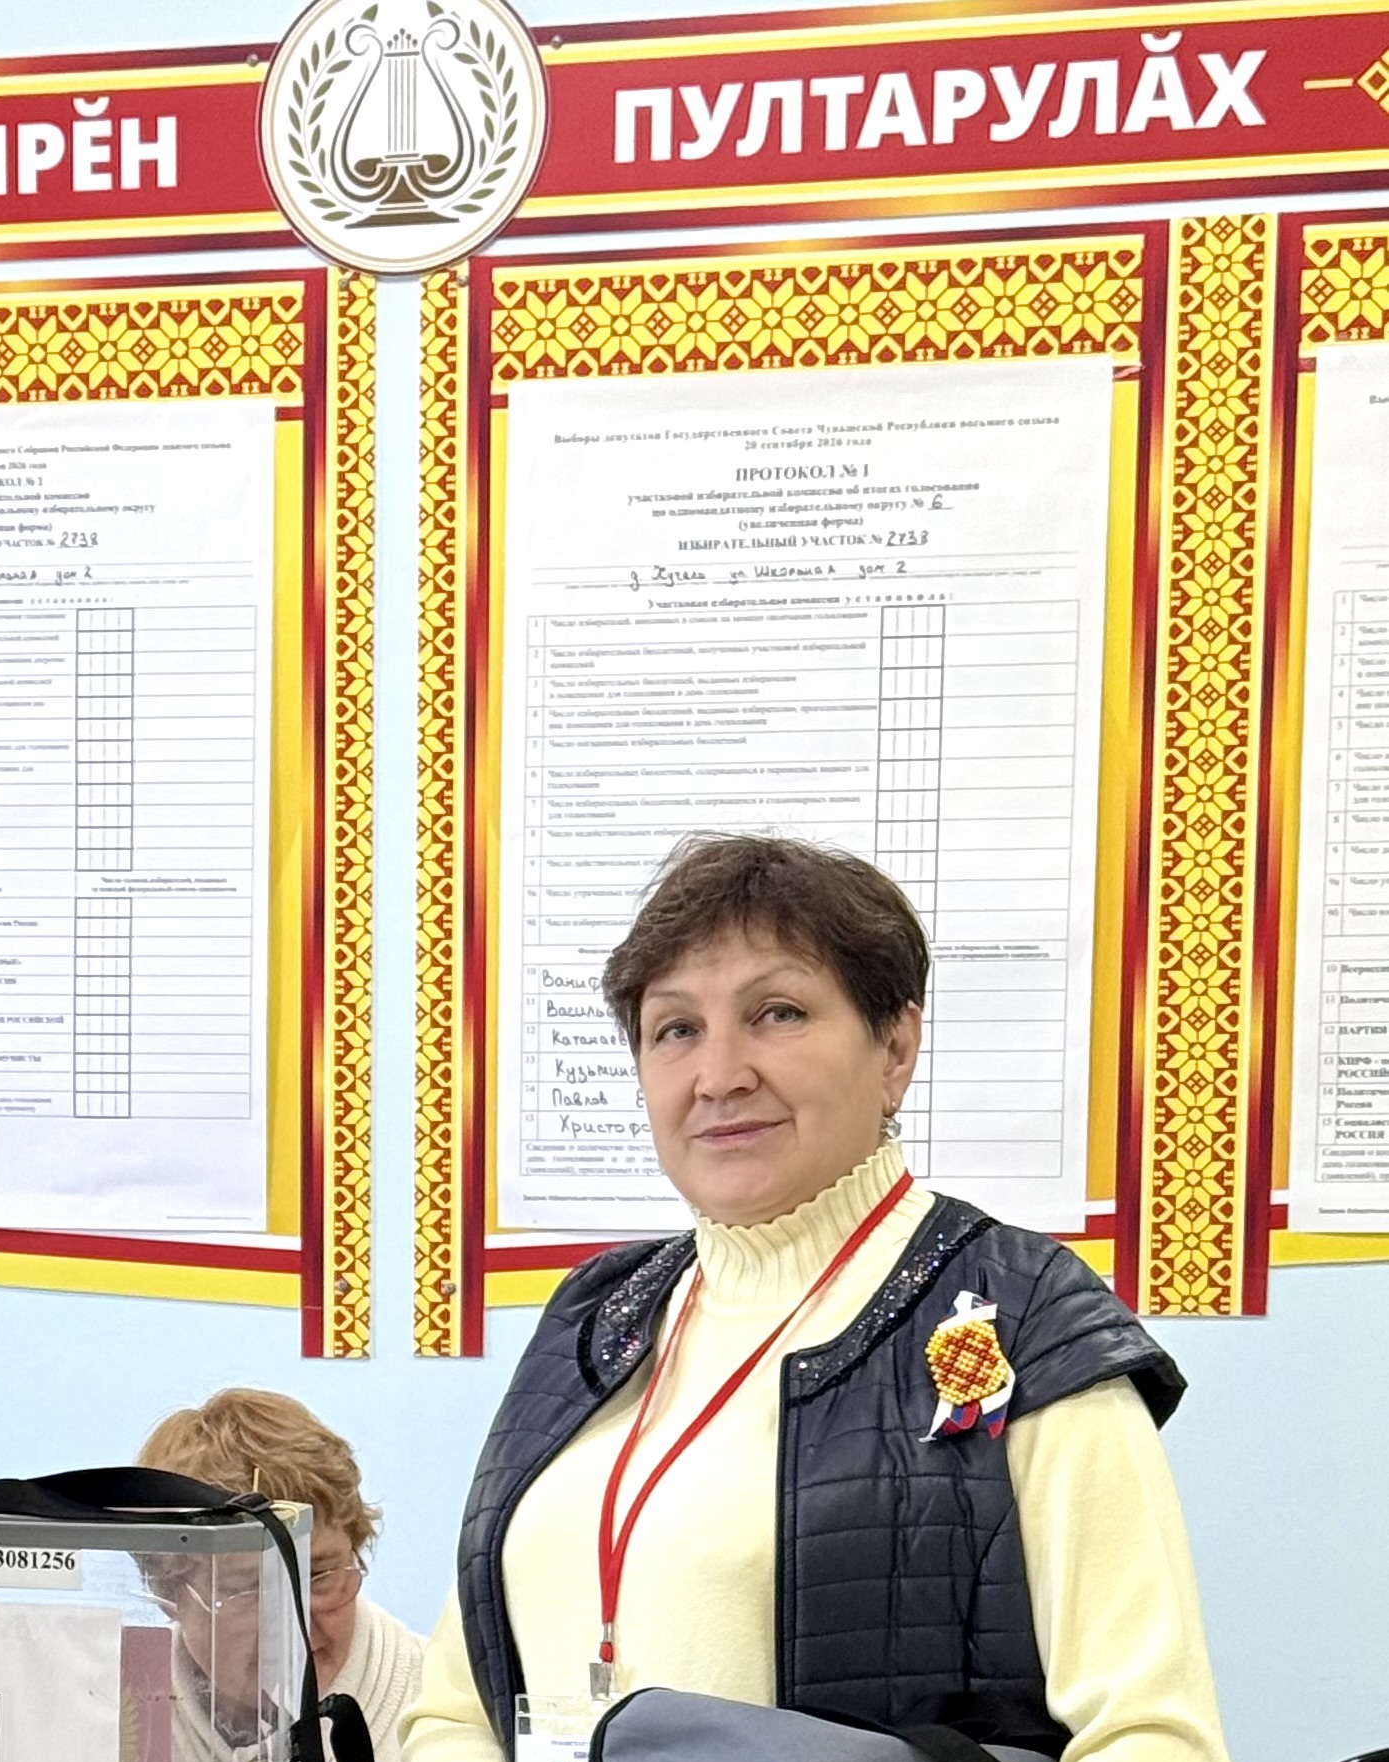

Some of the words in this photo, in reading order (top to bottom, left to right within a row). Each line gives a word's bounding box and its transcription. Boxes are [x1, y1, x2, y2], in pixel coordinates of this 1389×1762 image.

[613, 30, 1268, 164] ПУЛТАРУЛӐХ
[735, 464, 835, 482] ПРОТОКОЛ
[840, 463, 858, 478] №
[931, 493, 943, 509] 6
[58, 531, 99, 548] 2738
[885, 529, 929, 547] 2738
[895, 559, 908, 575] 2
[542, 968, 604, 991] Ваниф
[546, 999, 616, 1018] Василье
[551, 1087, 609, 1107] Павлов
[559, 1113, 652, 1138] Христофо
